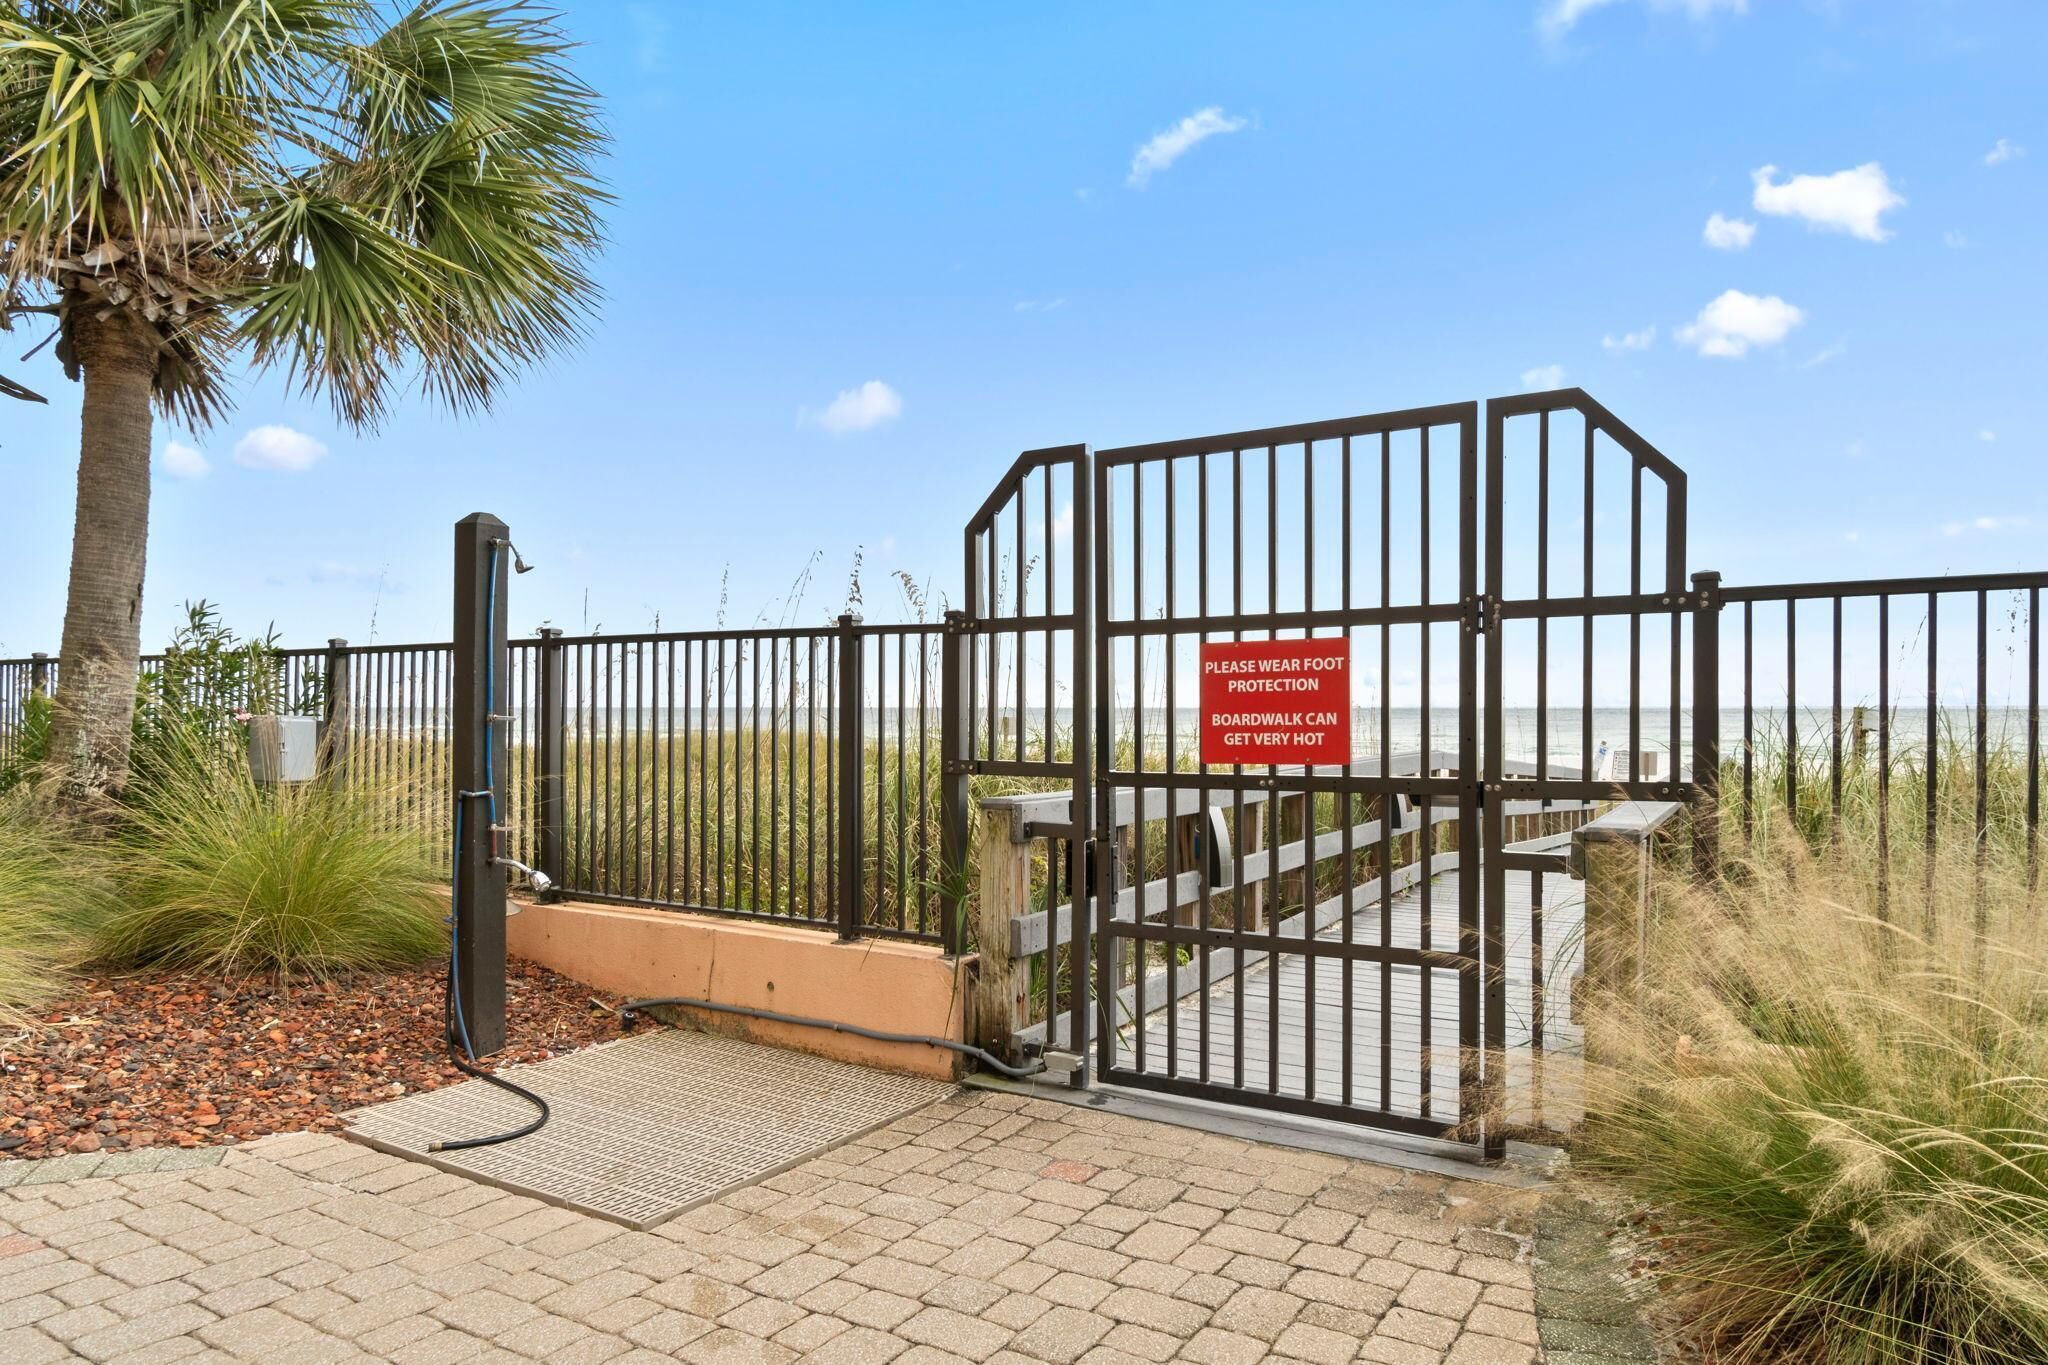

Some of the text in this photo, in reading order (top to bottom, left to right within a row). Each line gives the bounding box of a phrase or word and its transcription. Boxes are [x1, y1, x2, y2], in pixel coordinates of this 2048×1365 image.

[1205, 657, 1344, 674] PLEASE WEAR FOOT
[1228, 678, 1319, 693] PROTECTION
[1212, 712, 1337, 726] BOARDWALK CAN
[1224, 733, 1324, 745] GET VERY HOT
